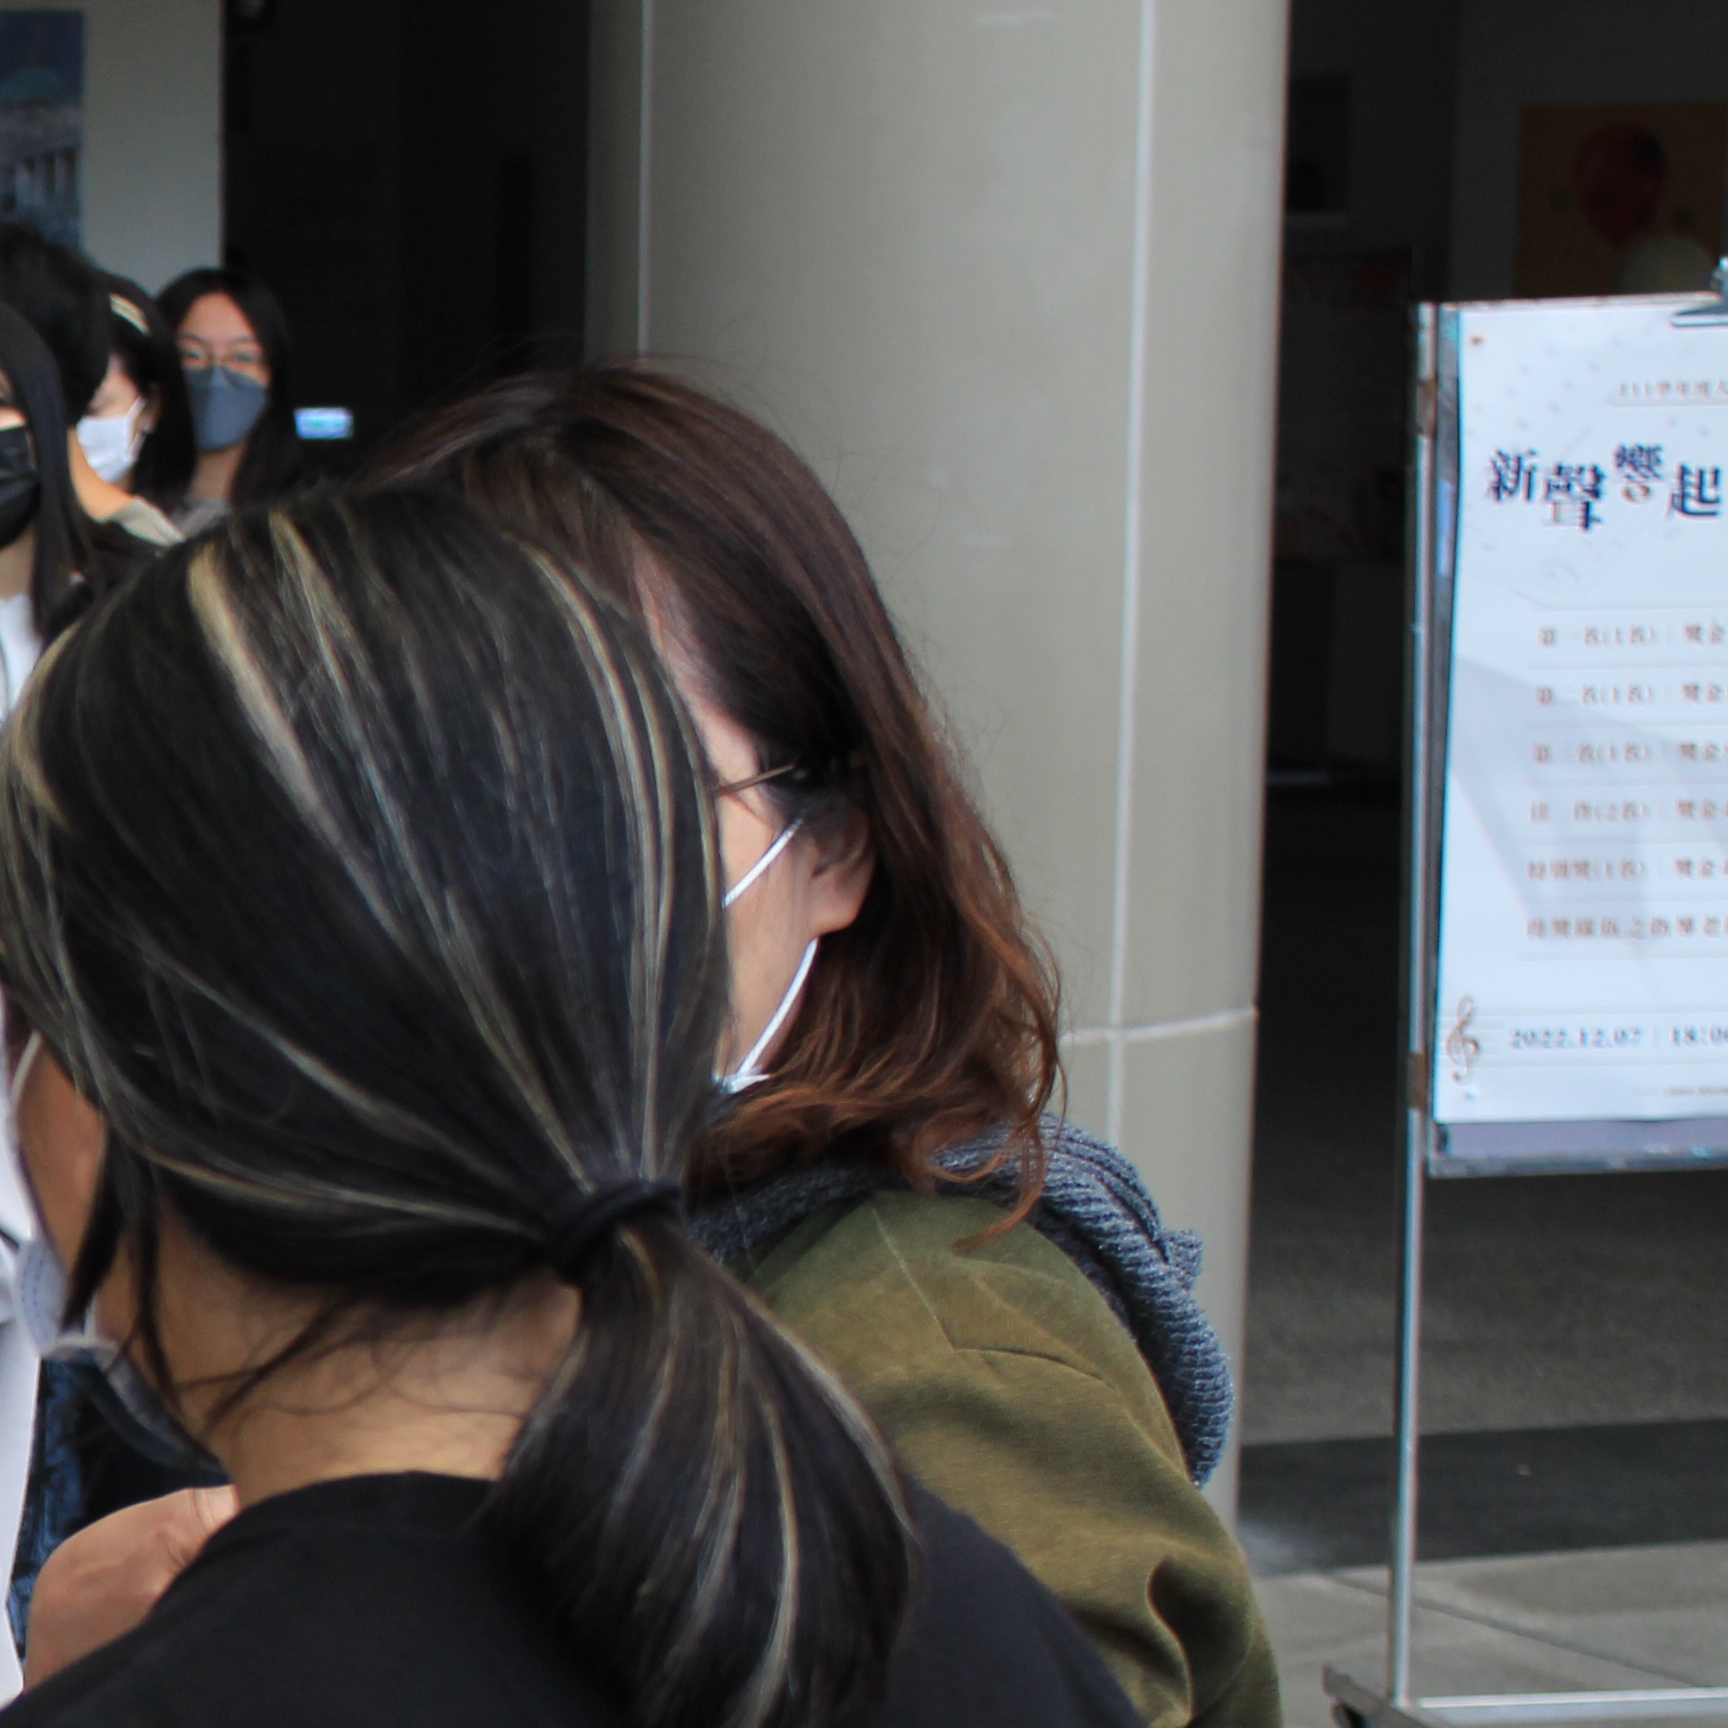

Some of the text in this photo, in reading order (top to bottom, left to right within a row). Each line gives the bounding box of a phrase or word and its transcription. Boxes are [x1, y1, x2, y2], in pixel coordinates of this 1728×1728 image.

[1486, 442, 1723, 532] 新聲響起
[1510, 1026, 1642, 1049] 2022.12.07
